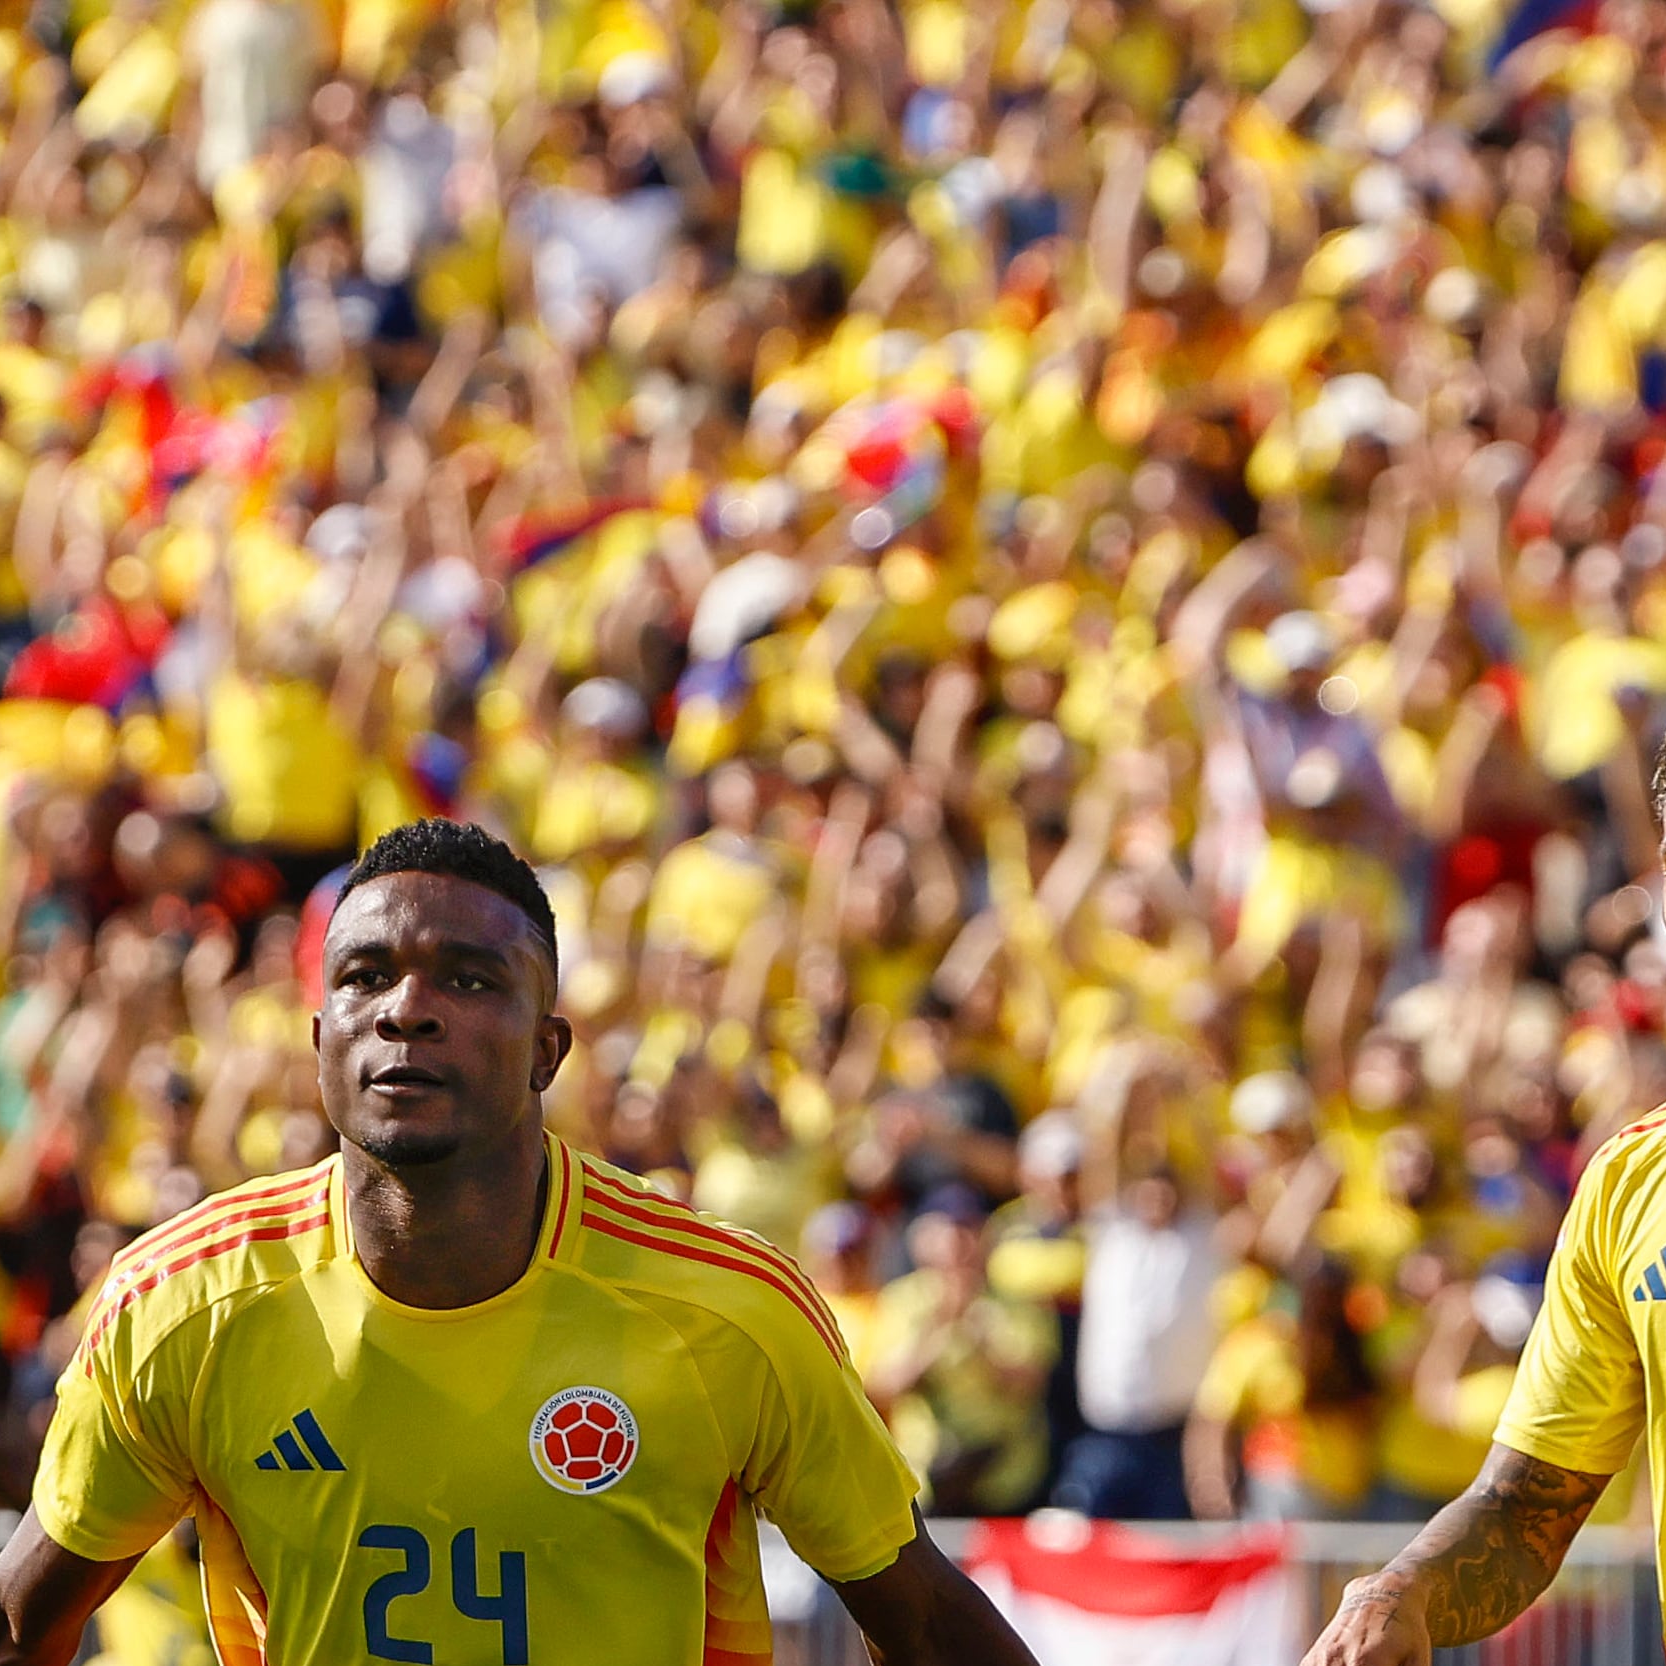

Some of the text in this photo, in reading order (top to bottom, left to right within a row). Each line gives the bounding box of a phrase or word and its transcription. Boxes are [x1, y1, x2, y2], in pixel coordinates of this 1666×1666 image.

[561, 1389, 612, 1404] COLOMBIANA
[611, 1400, 622, 1411] DE
[358, 1525, 528, 1666] 24
